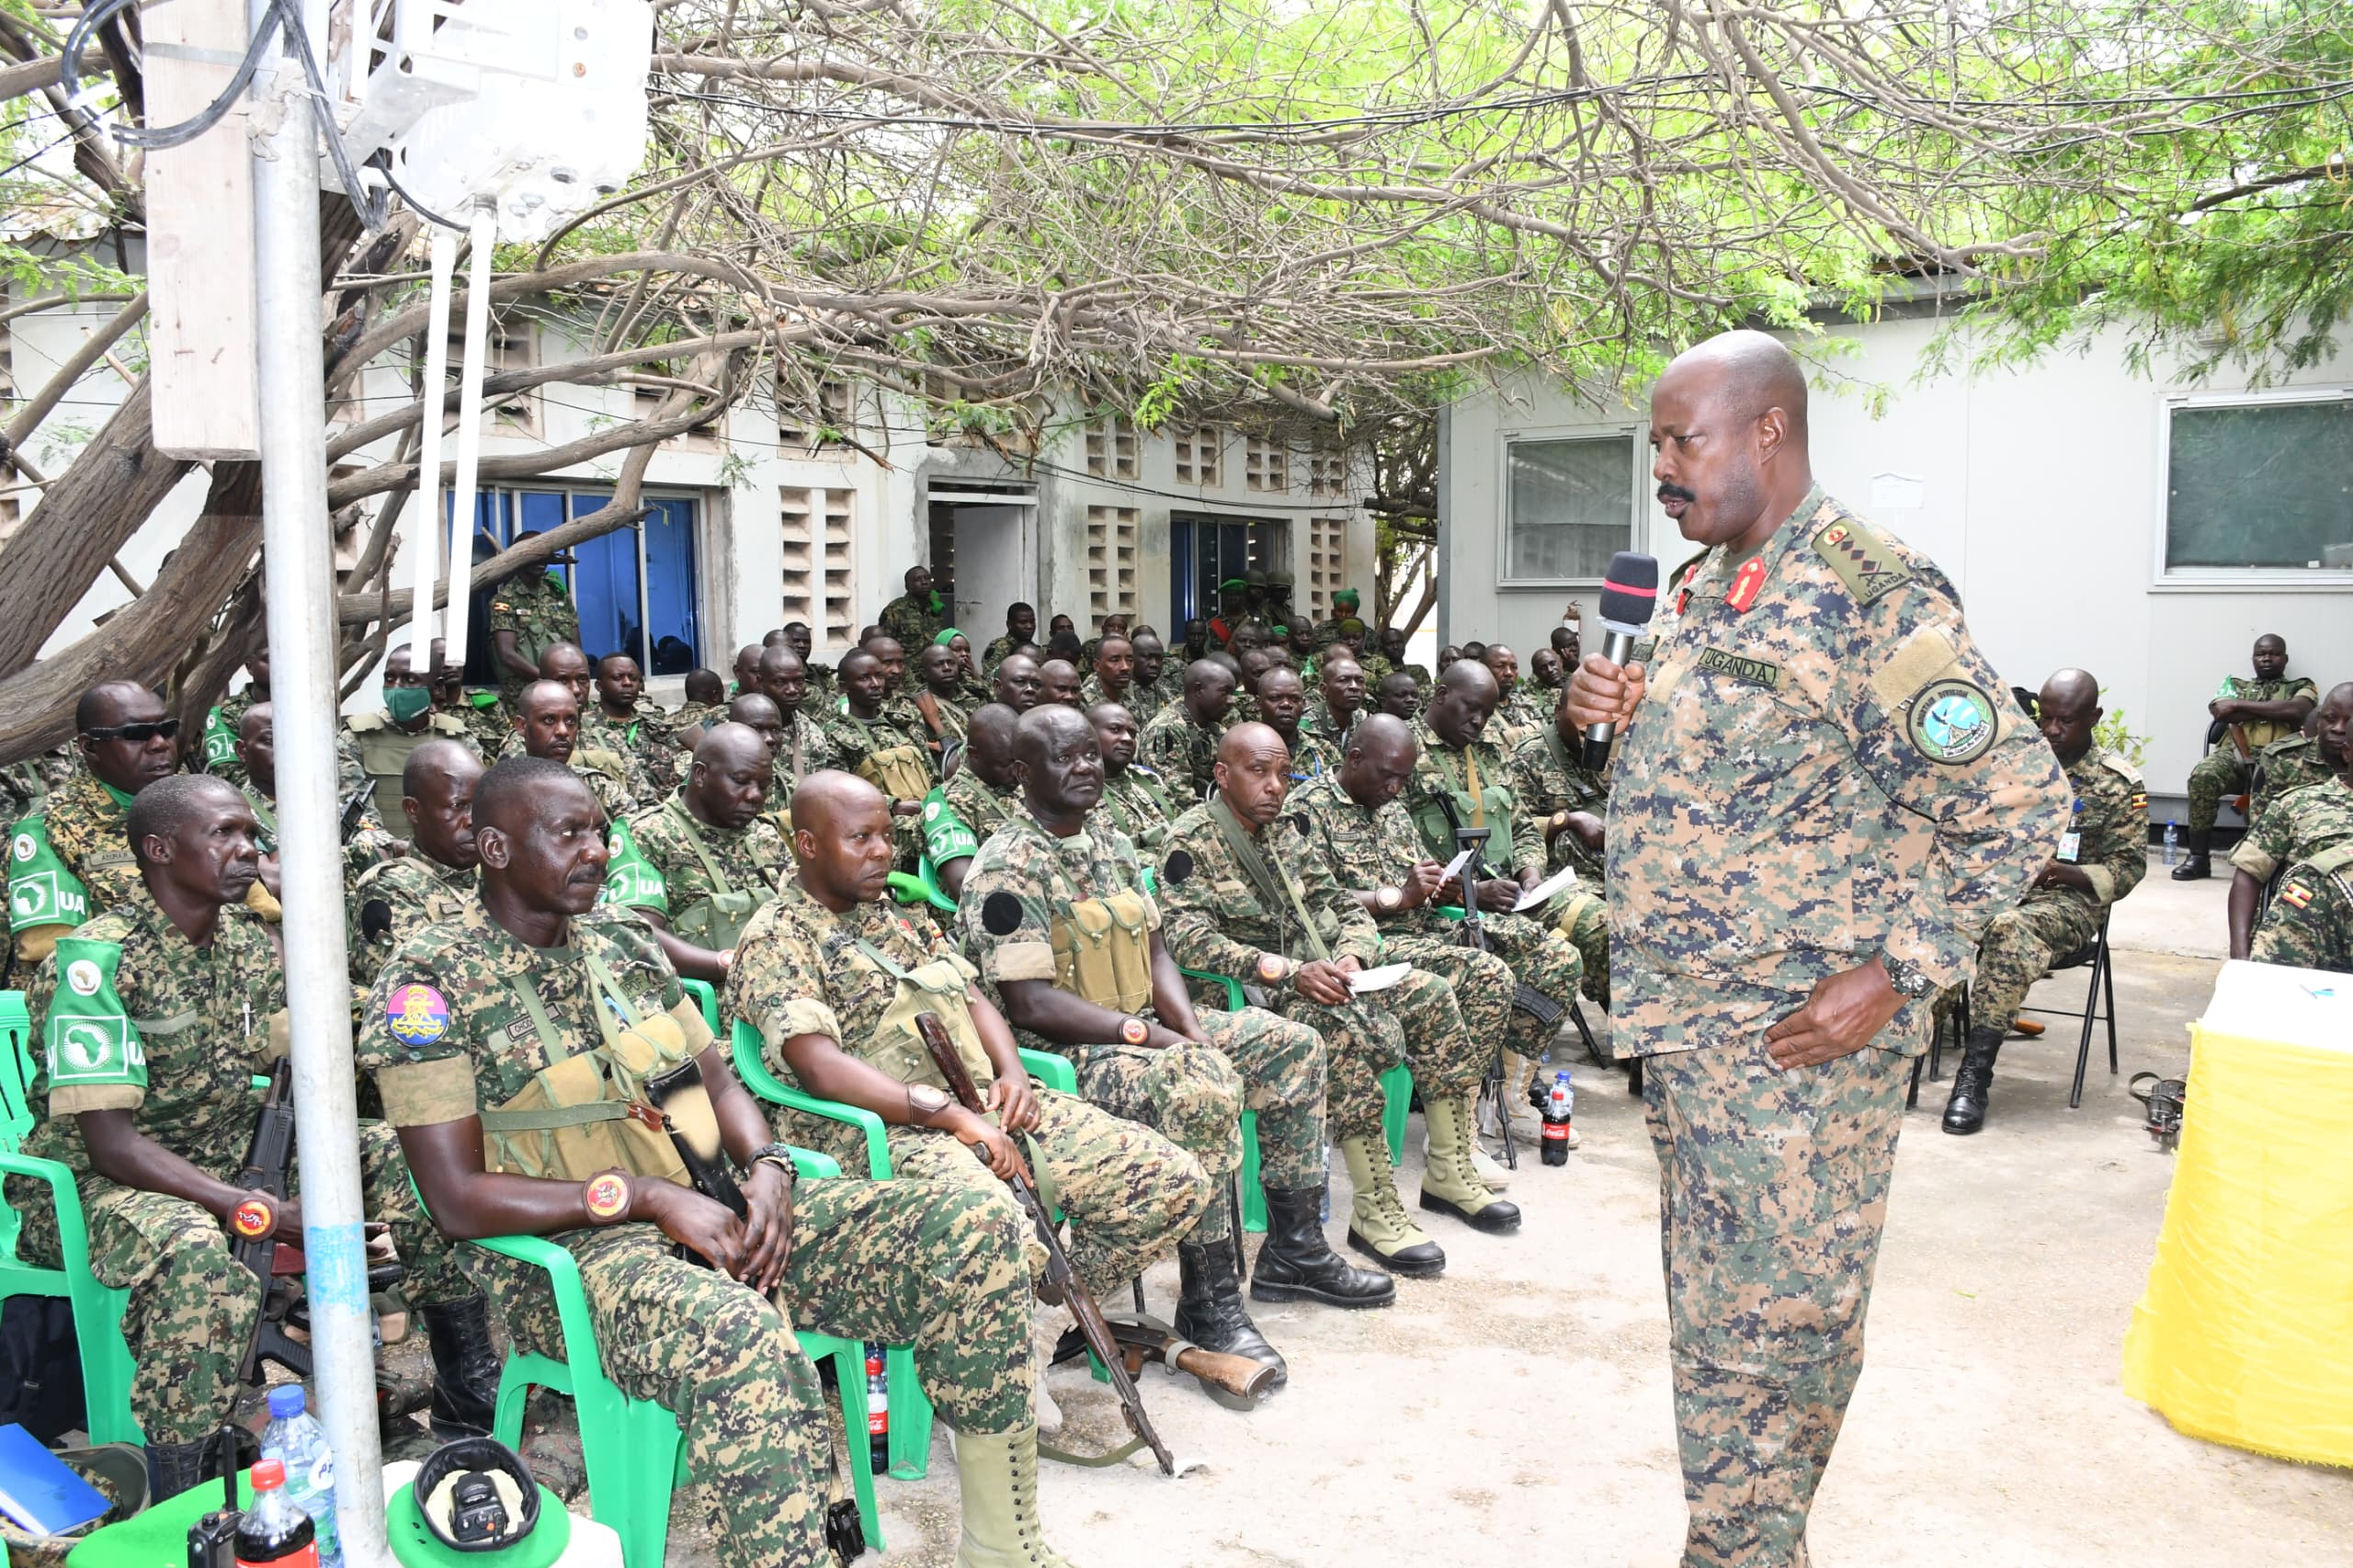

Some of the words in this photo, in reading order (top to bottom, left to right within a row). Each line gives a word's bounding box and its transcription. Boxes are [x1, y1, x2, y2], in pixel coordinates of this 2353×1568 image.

[1864, 573, 1905, 597] UGANDA
[1705, 652, 1767, 682] UGANDA
[956, 833, 976, 846] UA
[640, 880, 665, 898] UA
[59, 890, 85, 915] UA
[128, 1040, 146, 1065] U
